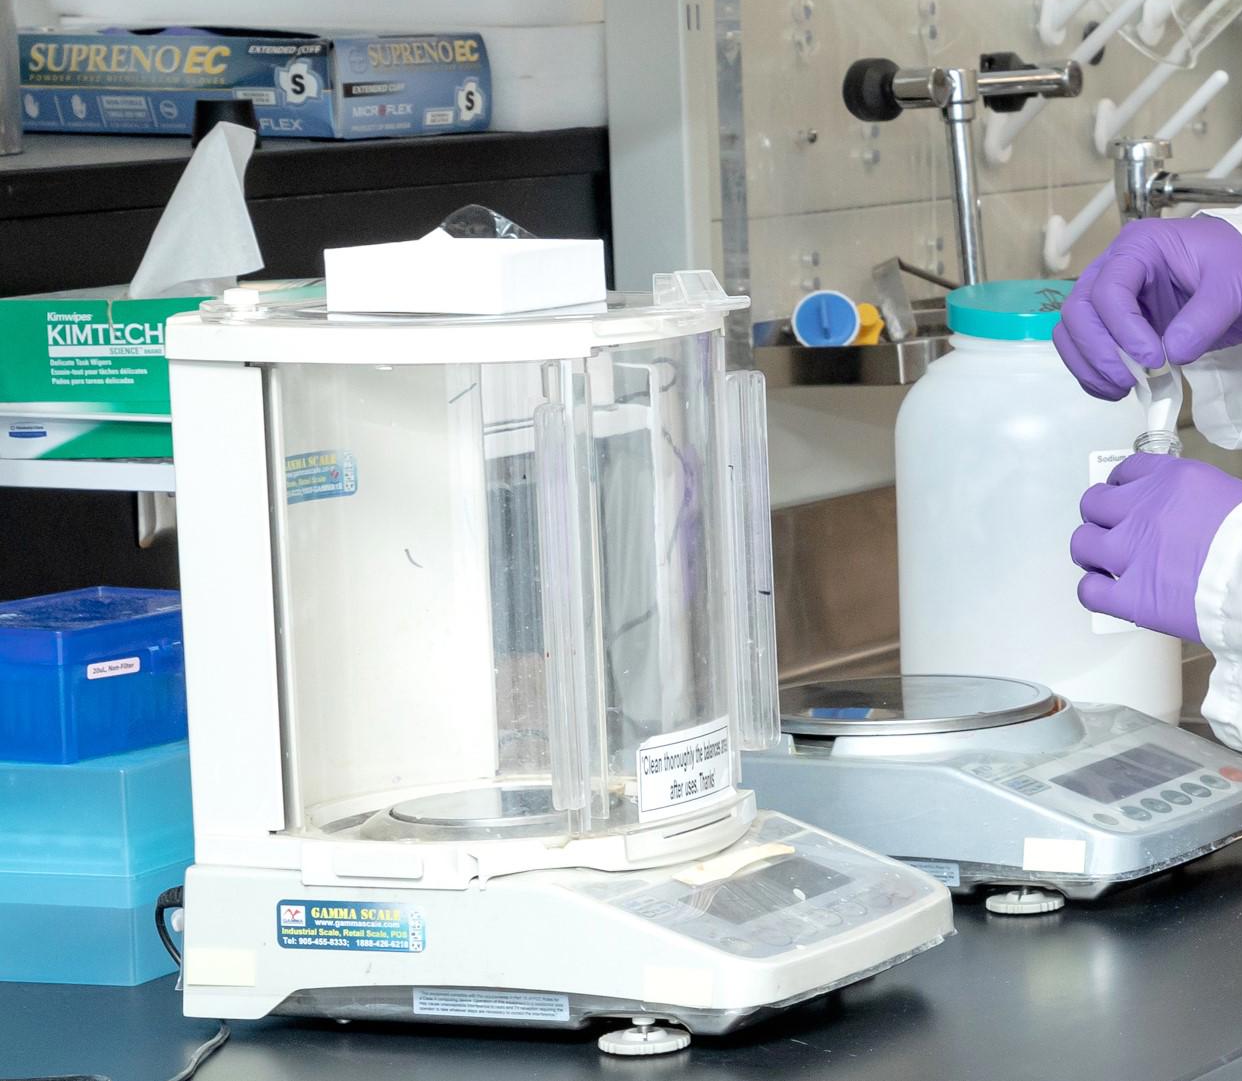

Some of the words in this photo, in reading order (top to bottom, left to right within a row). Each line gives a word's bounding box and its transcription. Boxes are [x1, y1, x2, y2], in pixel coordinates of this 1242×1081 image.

[28, 43, 182, 74] SUPRENO
[184, 45, 232, 75] EC
[367, 40, 453, 68] SUPRENO
[454, 39, 479, 63] EC
[291, 73, 305, 95] S
[465, 90, 475, 112] S
[47, 322, 164, 345] KIMTECH
[663, 748, 695, 773] thoroughly
[695, 746, 703, 764] the
[670, 779, 684, 800] after
[311, 907, 357, 920] GAMMA
[360, 908, 401, 921] SCALE
[281, 927, 318, 937] Industrial
